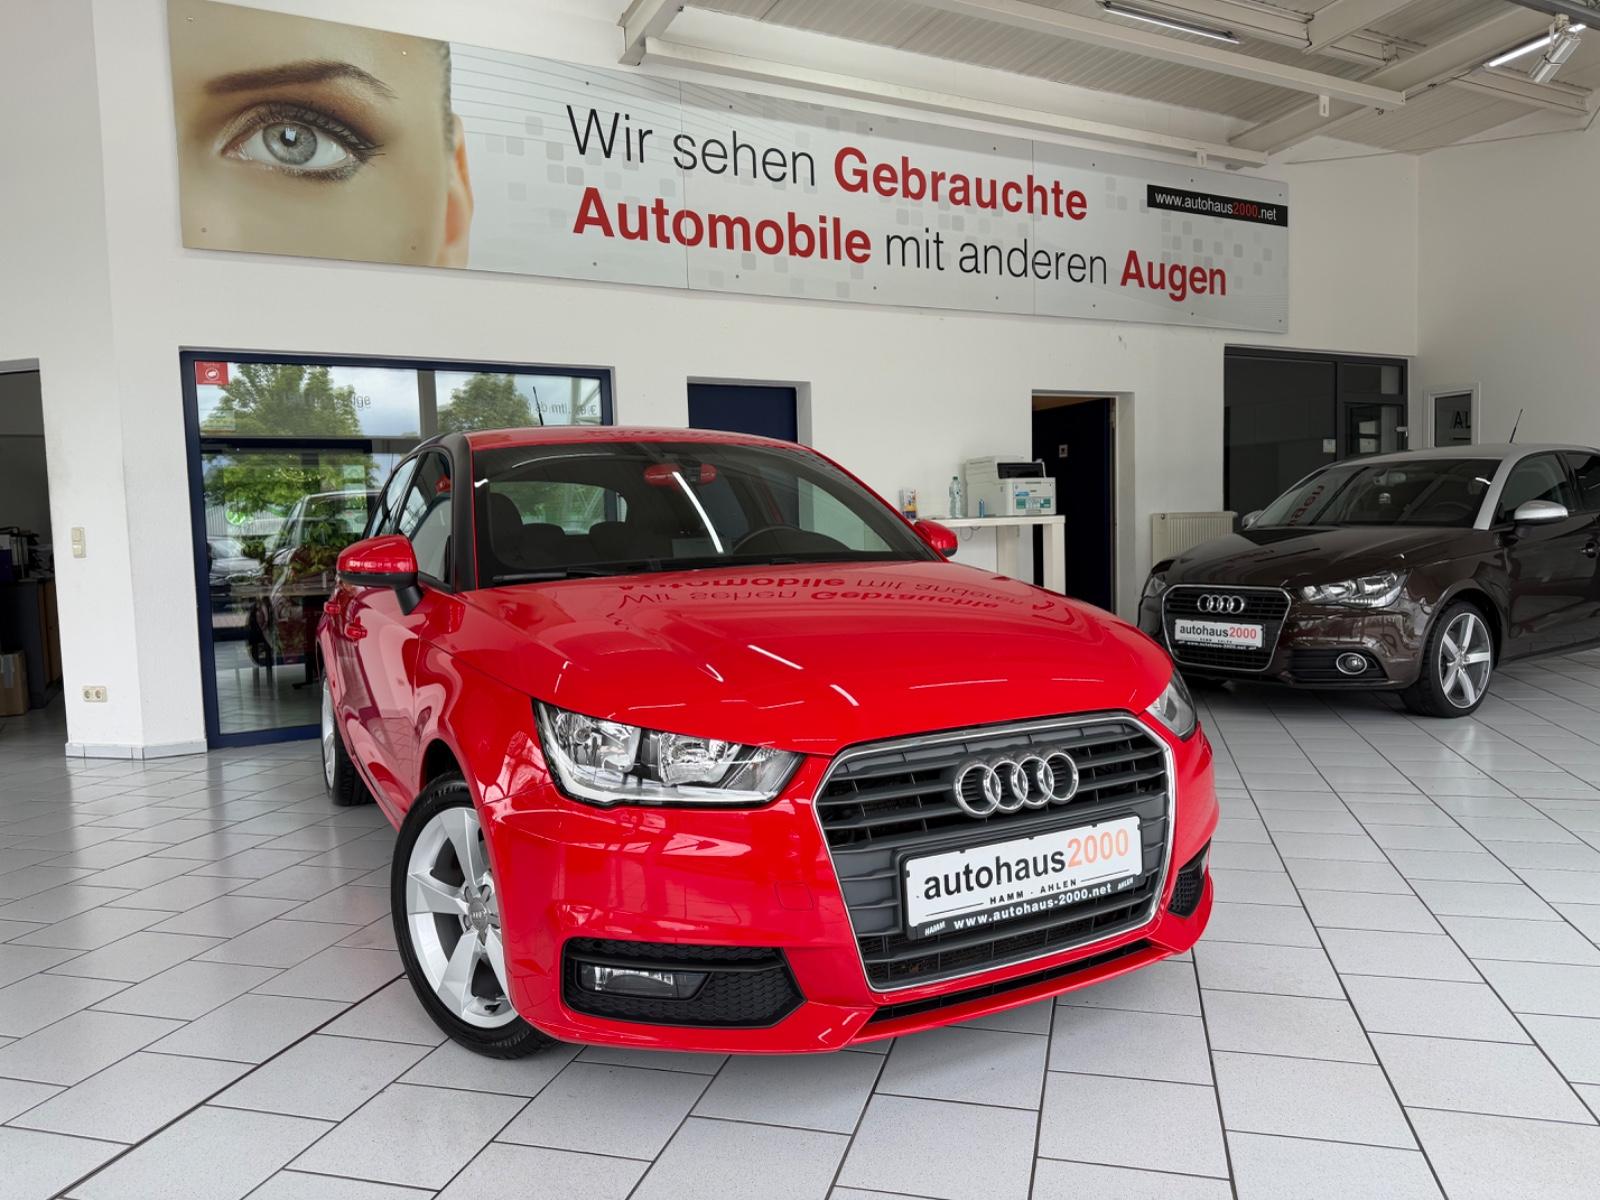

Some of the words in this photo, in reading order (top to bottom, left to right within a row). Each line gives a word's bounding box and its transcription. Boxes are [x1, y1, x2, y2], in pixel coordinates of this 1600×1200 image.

[566, 104, 653, 163] Wir
[673, 130, 815, 186] sehen
[834, 146, 1088, 220] Gebrauchte
[1154, 191, 1277, 221] www.autohaus2000.net
[573, 186, 871, 264] Automobile
[886, 227, 944, 271] mit
[959, 238, 1107, 284] anderen
[1120, 250, 1227, 302] Augen
[1180, 625, 1257, 640] autohaus2000
[923, 828, 1130, 900] autohaus2000
[989, 890, 1025, 905] HAMM
[1039, 878, 1077, 895] AHLEN
[924, 921, 946, 936] HAMM
[953, 883, 1112, 931] www.autohaus-2000.net
[1117, 877, 1135, 891] AHLEN
